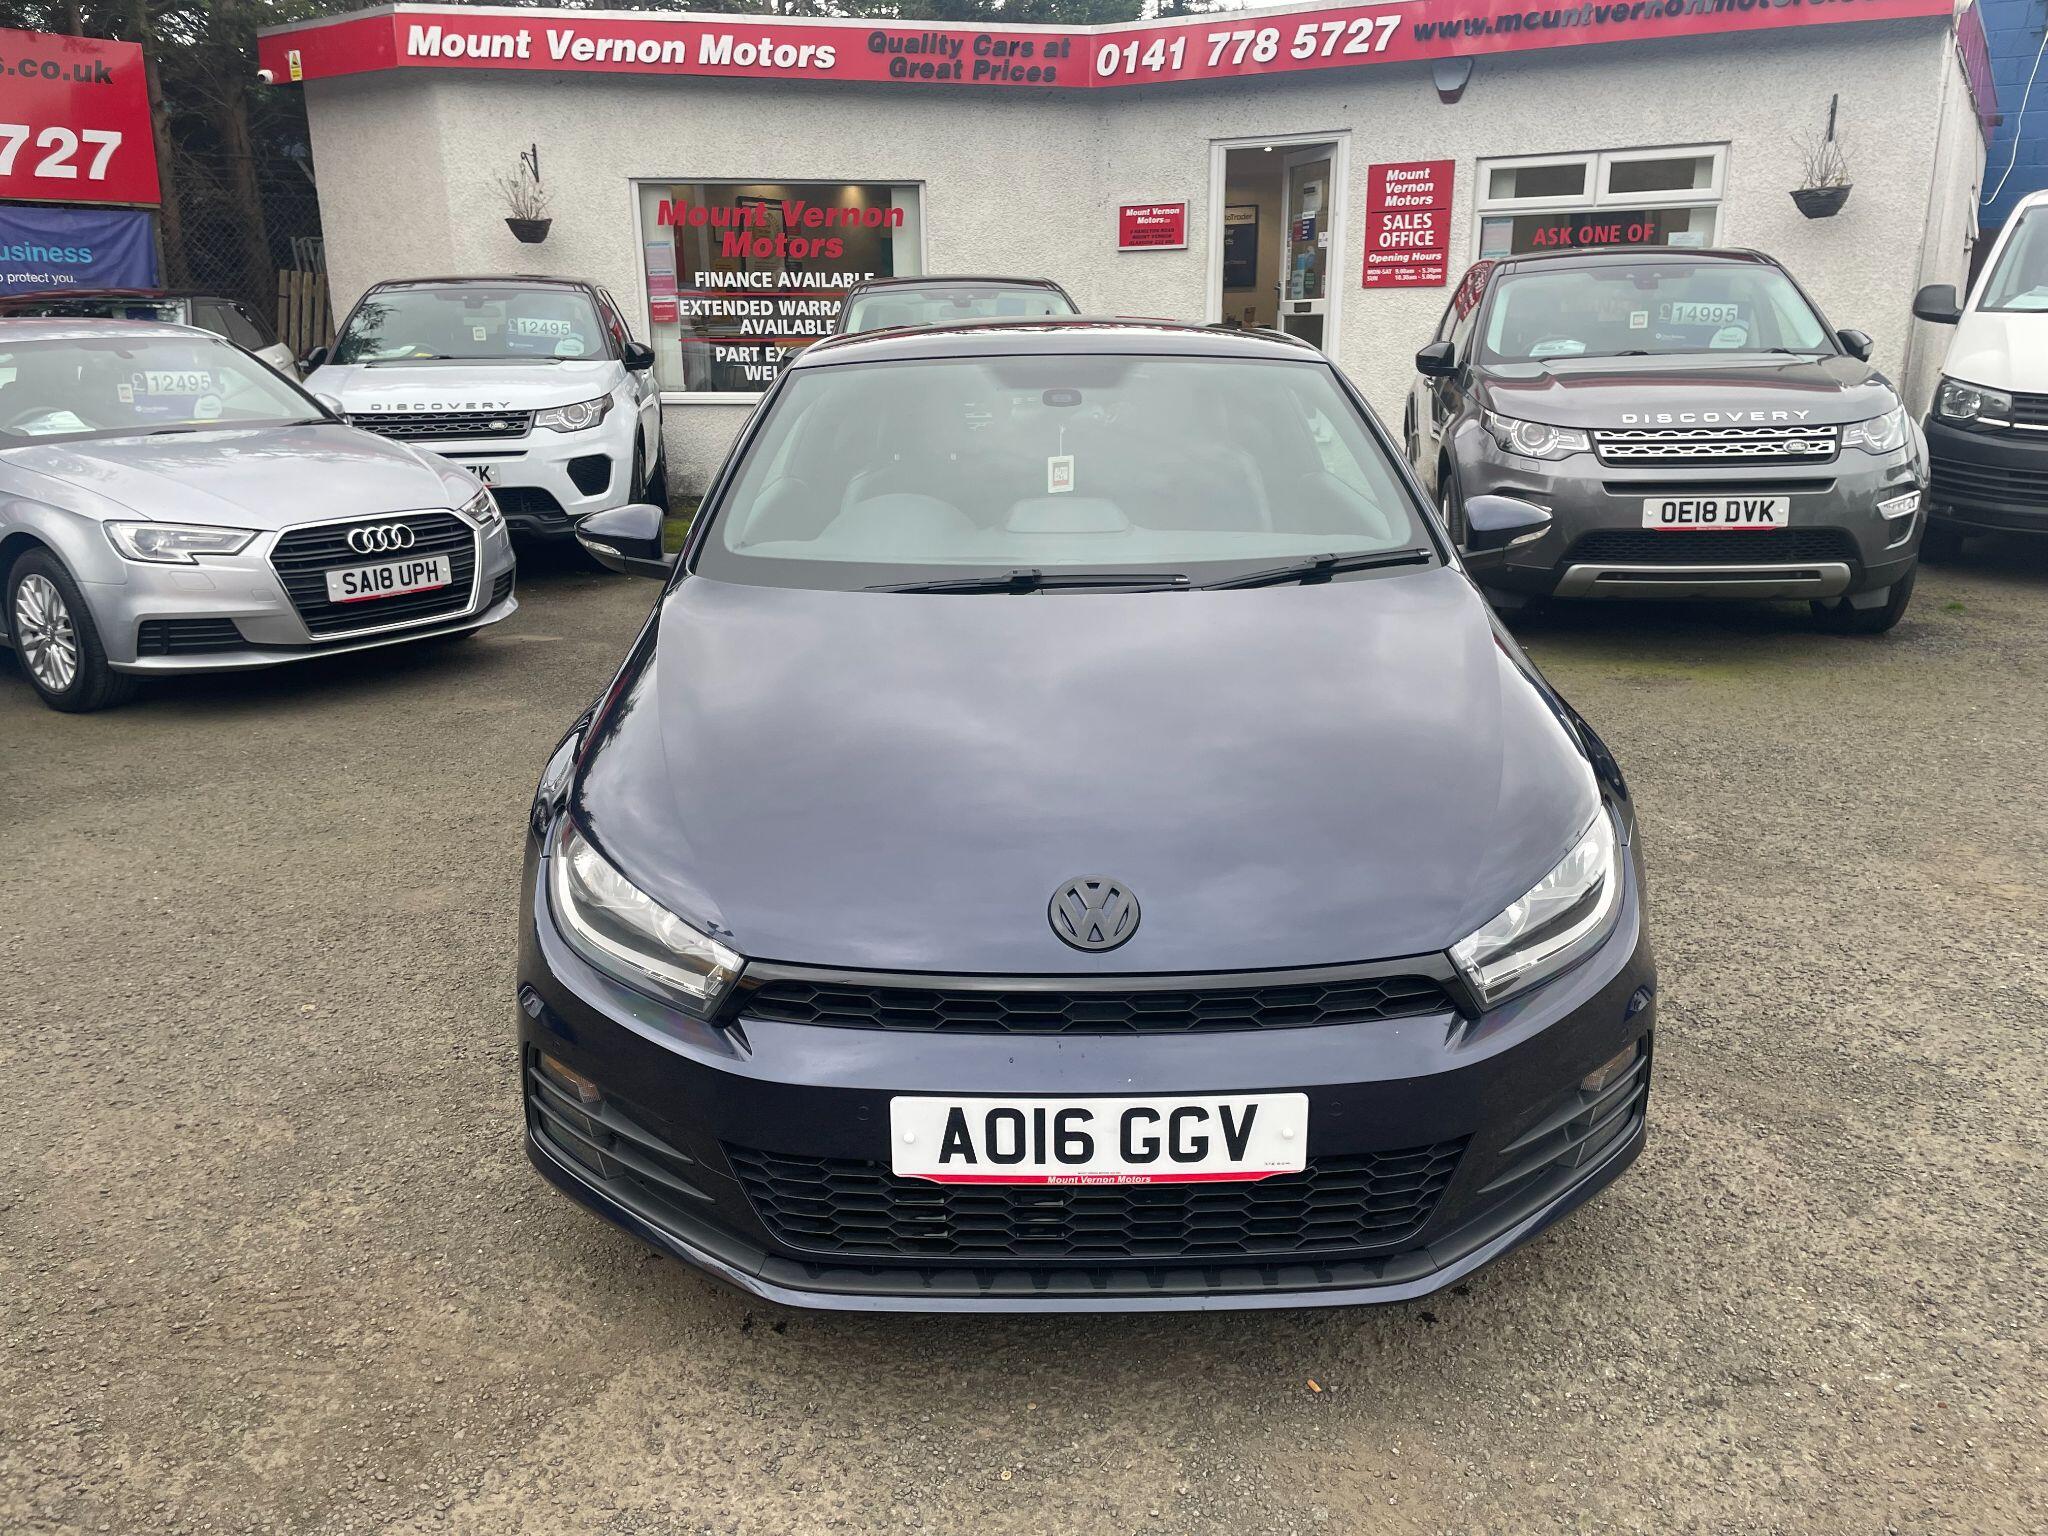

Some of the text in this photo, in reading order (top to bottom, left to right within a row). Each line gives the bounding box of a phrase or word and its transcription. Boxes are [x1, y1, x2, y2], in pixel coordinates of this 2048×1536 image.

[407, 25, 837, 69] Mount Vernon Motors
[868, 31, 1071, 58] Quality Cars at
[1096, 15, 1402, 77] 0141 778 5727
[0, 57, 113, 84] .co.uk
[890, 57, 1057, 82] Great Prices
[1386, 168, 1431, 181] Mount
[1385, 182, 1434, 194] Vernon
[1384, 195, 1434, 207] Motors
[657, 200, 905, 228] Mount Vernon
[1126, 207, 1180, 217] Mount Vernon
[1136, 216, 1164, 224] Motors
[1383, 213, 1432, 230] SALES
[1379, 230, 1434, 247] OFFICE
[1533, 223, 1656, 246] ASK ONE OF
[722, 231, 844, 258] Motors
[1368, 252, 1442, 264] Opening Hours
[7, 272, 50, 285] protect
[50, 273, 77, 286] you.
[694, 271, 772, 288] FINANCE
[680, 300, 842, 316] EXTENDED WARRA
[715, 346, 795, 362] PART EX
[370, 401, 511, 411] DISCOVERY
[1622, 409, 1810, 424] DISCOVERY
[1661, 500, 1775, 524] OE18 DVK
[342, 561, 438, 595] SA18 UPH
[938, 1103, 1259, 1165] AO16 GGV
[1047, 1174, 1151, 1184] Mount Vernon Motors
